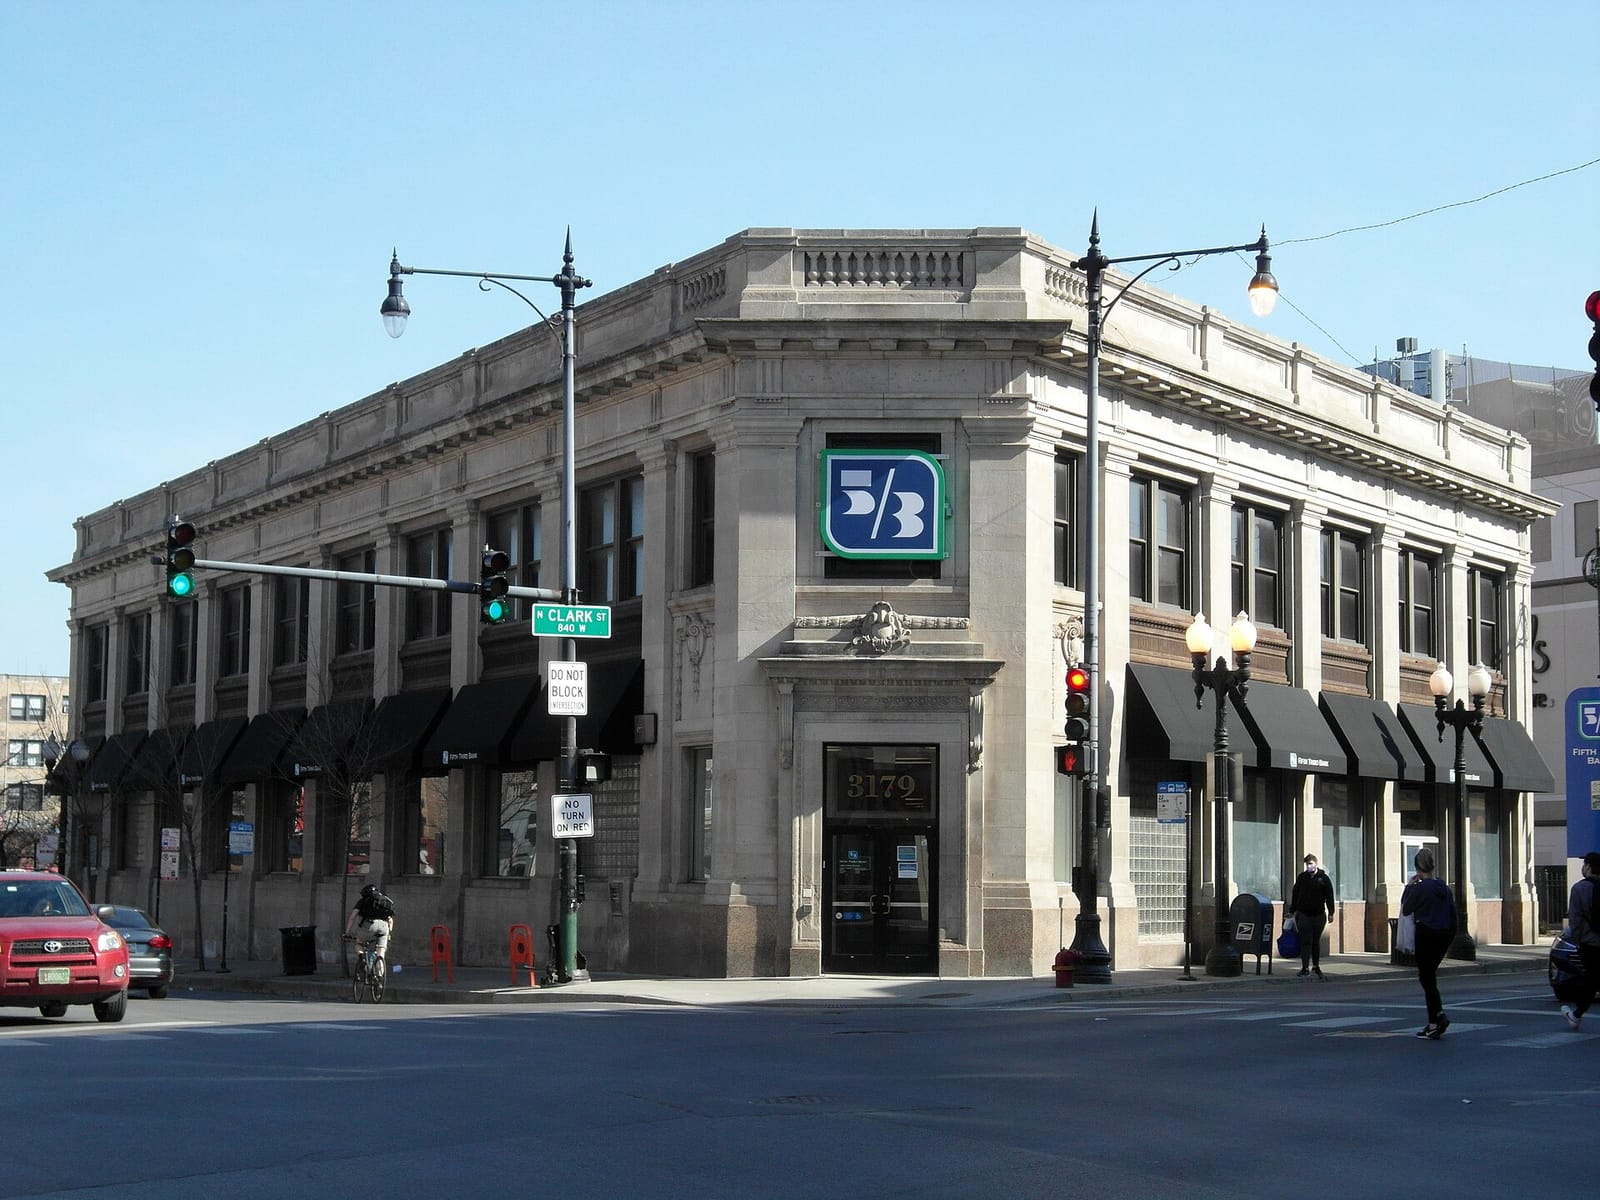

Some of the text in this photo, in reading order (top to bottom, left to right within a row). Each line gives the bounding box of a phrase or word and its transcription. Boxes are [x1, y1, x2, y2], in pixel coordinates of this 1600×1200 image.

[537, 609, 607, 623] N CLARK ST
[558, 623, 587, 633] 840 W
[551, 669, 584, 681] DO NOT
[551, 685, 584, 698] BLOCK
[1572, 748, 1597, 756] FIFTH
[1587, 757, 1600, 765] BA
[847, 774, 916, 798] 3179
[564, 800, 579, 809] NO
[561, 812, 584, 820] TURN
[556, 823, 568, 832] ON
